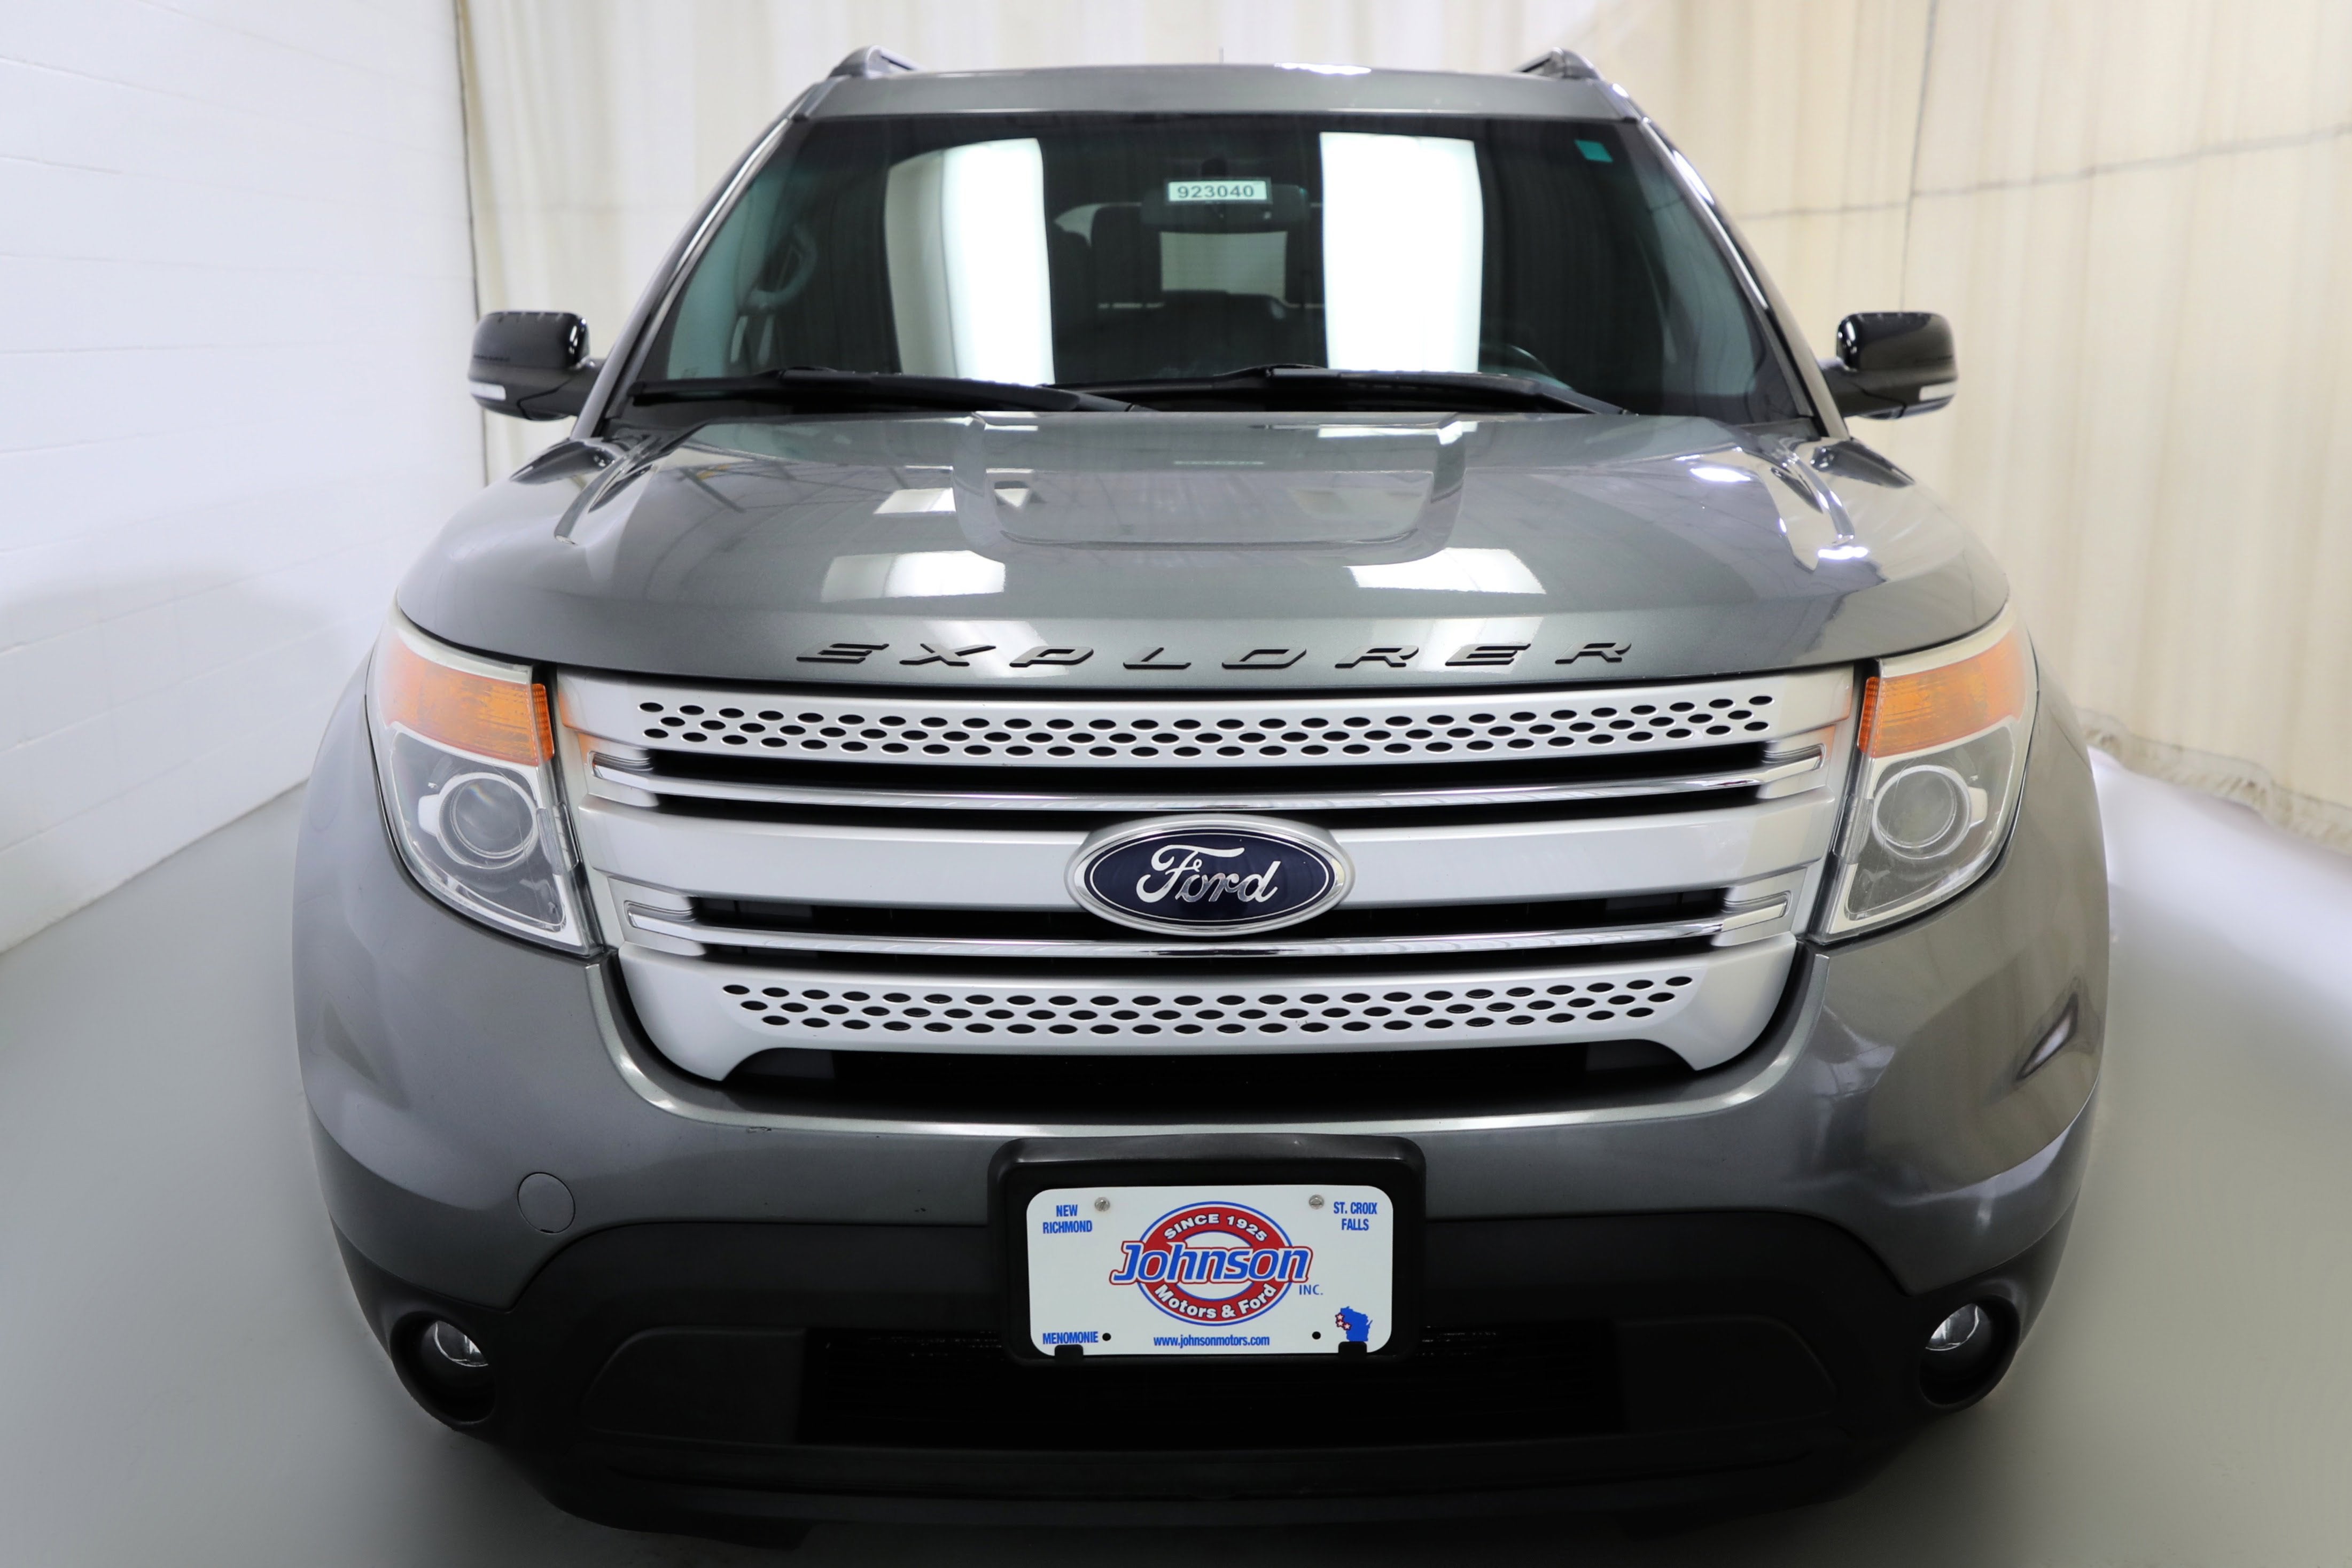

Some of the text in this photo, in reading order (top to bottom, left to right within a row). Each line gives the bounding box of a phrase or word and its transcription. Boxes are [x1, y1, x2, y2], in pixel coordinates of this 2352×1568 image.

[1178, 185, 1255, 198] 923040
[796, 641, 1632, 670] EXPLORER
[1136, 844, 1281, 903] Ford
[1056, 1204, 1078, 1217] NEW
[1333, 1201, 1377, 1214] ST. CROIX
[1042, 1220, 1093, 1234] RICHMOND
[1164, 1213, 1268, 1242] SINCE 1925
[1341, 1218, 1369, 1231] FALLS
[1111, 1242, 1311, 1282] Johnson
[1298, 1284, 1323, 1296] INC.
[1154, 1283, 1277, 1319] Motors & Ford
[1042, 1331, 1099, 1345] MENOMONIE
[1153, 1334, 1270, 1349] www.johnsonmotors.com
